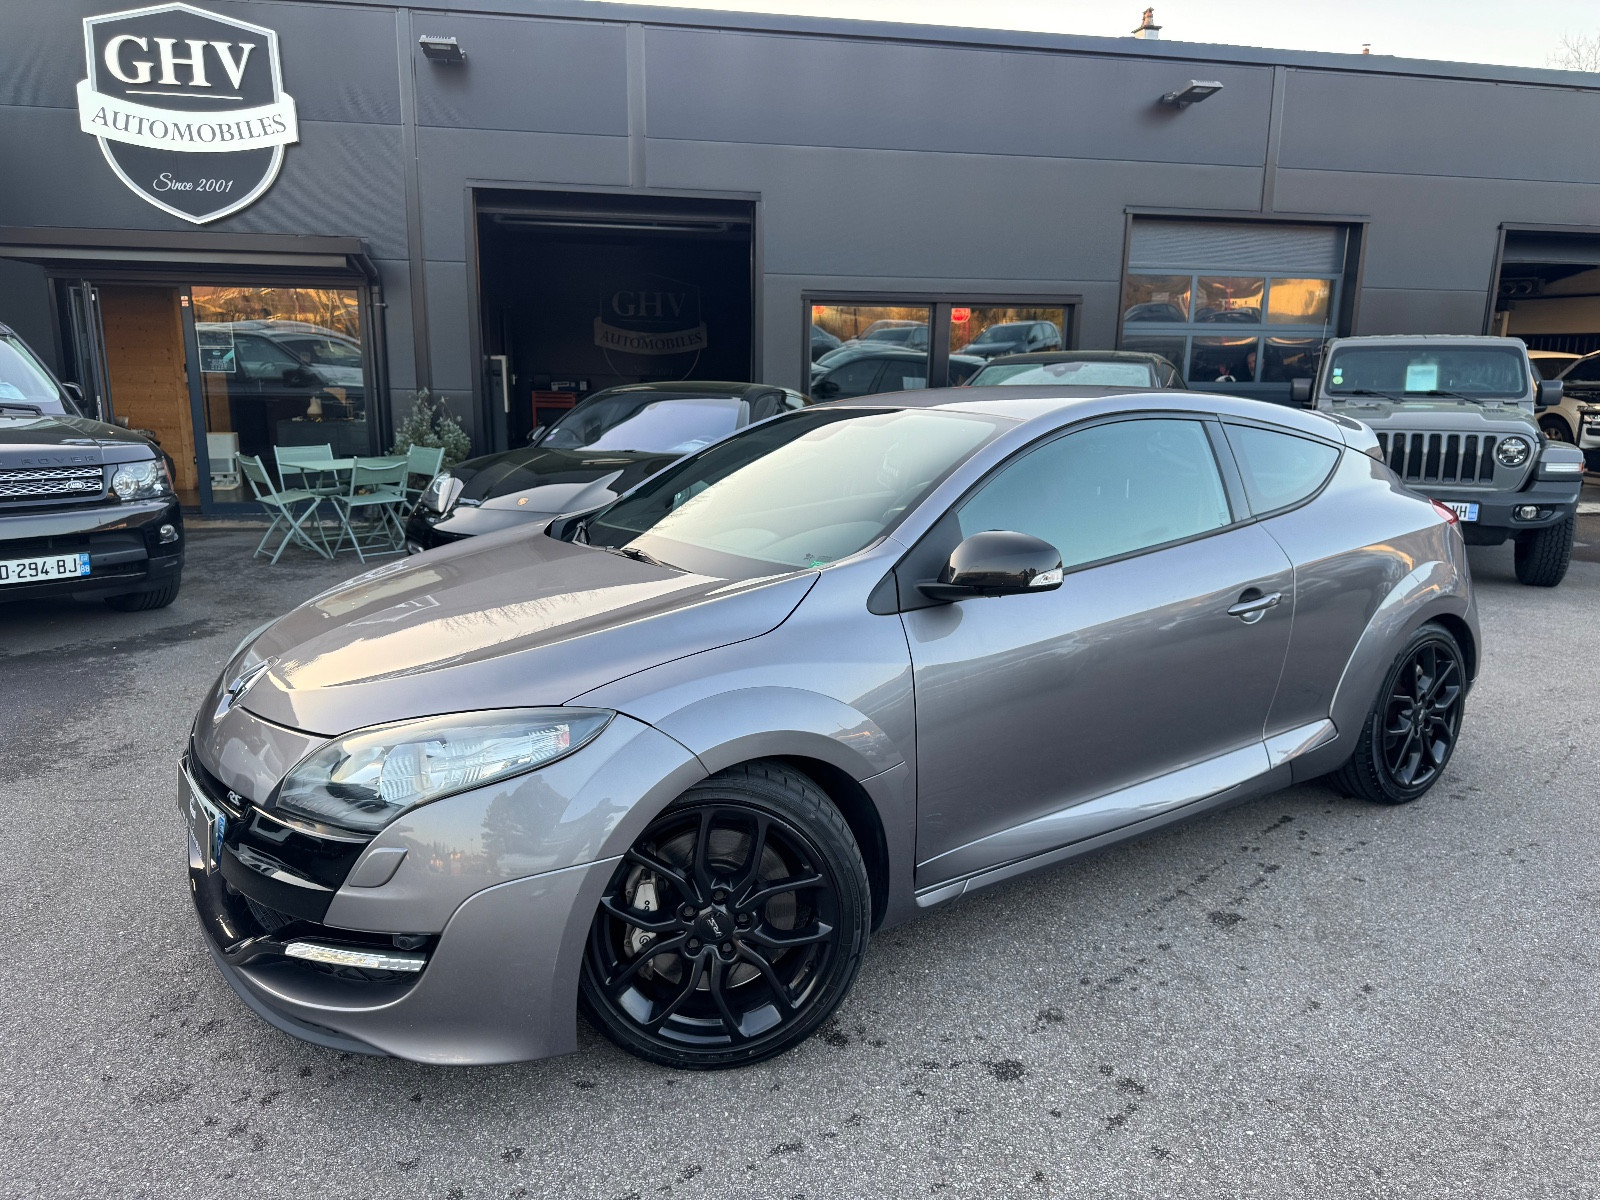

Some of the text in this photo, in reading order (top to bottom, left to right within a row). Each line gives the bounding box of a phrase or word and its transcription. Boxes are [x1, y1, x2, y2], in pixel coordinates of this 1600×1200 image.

[104, 34, 256, 90] GHV
[91, 106, 287, 143] AUTOMOBILES
[153, 172, 233, 193] Since 2001
[612, 290, 686, 318] GHV
[600, 329, 703, 350] AUTOMOBILES
[20, 455, 97, 466] ROVER
[227, 790, 242, 806] RS
